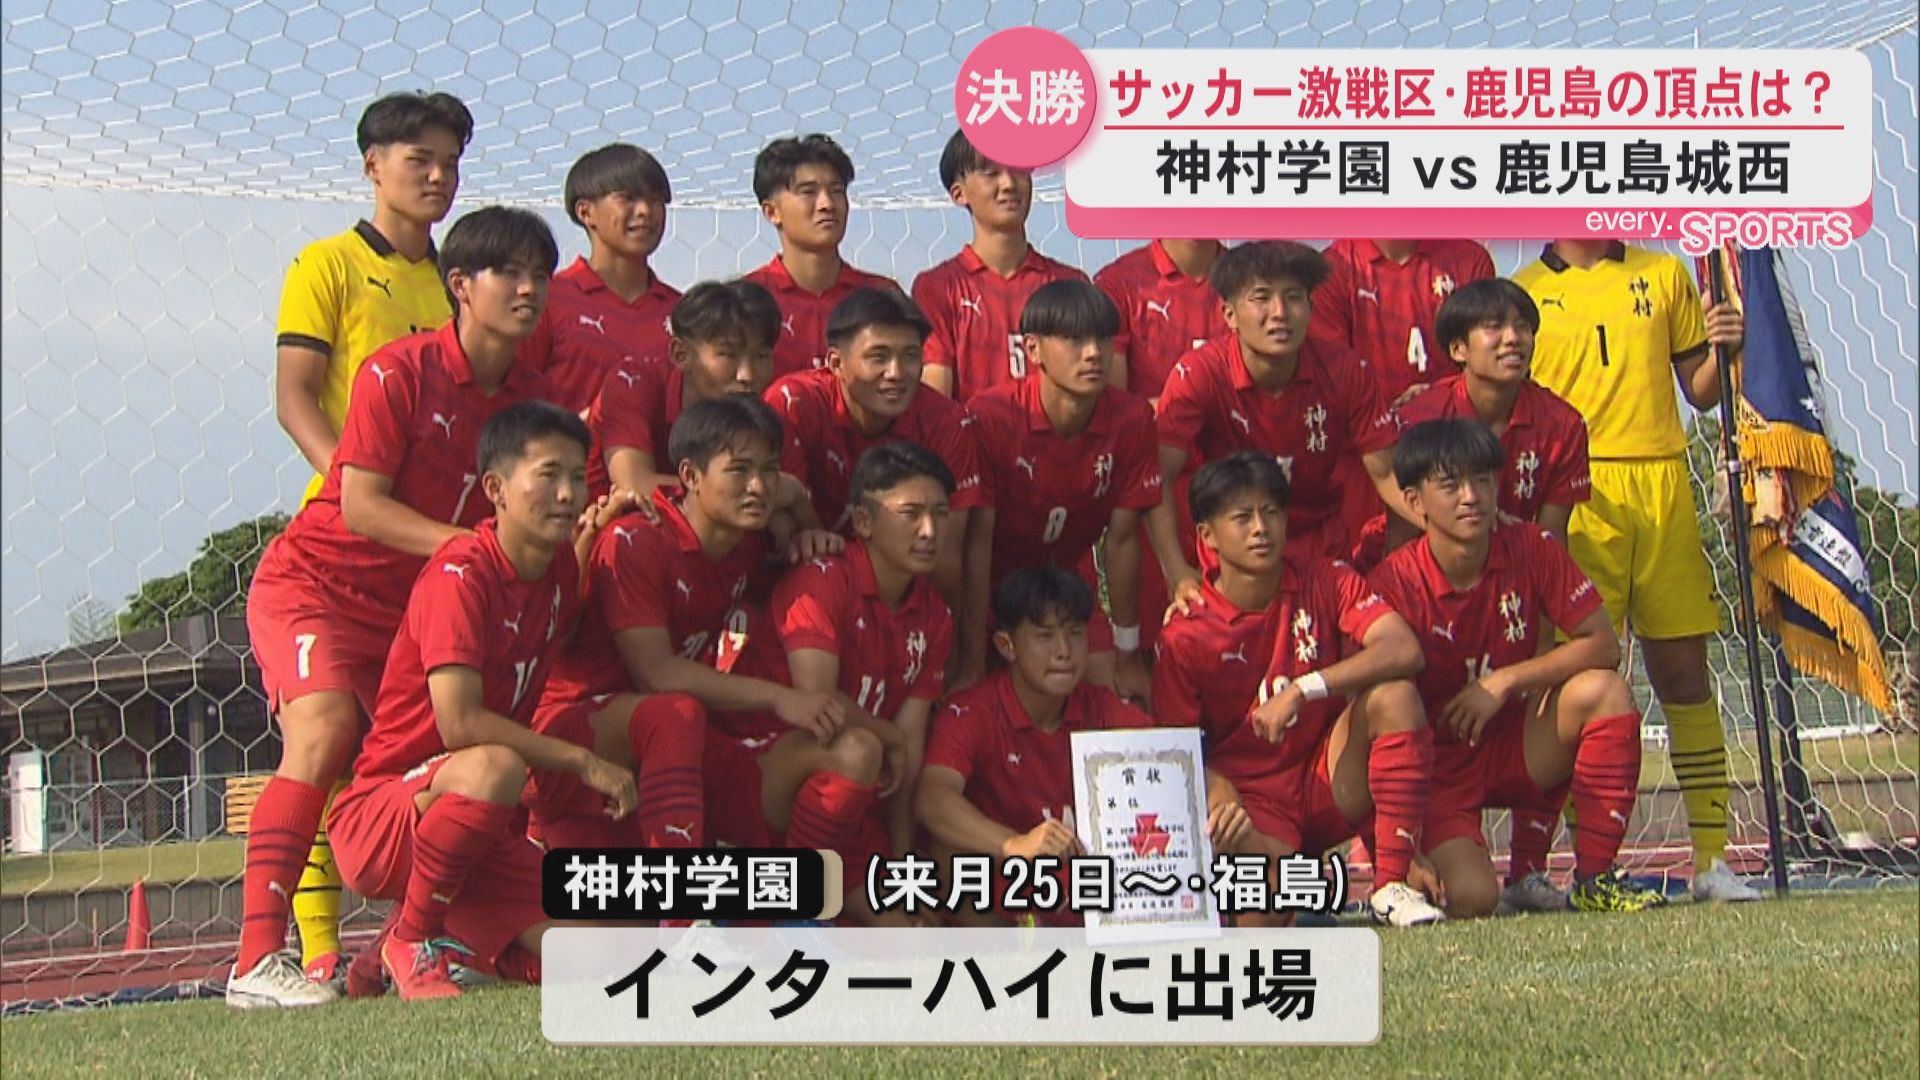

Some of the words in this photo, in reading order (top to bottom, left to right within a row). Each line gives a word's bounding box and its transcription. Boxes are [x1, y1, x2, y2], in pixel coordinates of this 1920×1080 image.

[1628, 276, 1652, 318] 神村
[1007, 333, 1027, 379] 5
[1407, 327, 1428, 373] 4
[1596, 324, 1610, 367] 1
[1303, 402, 1328, 453] 神村
[1514, 451, 1540, 499] 神村
[1043, 506, 1067, 543] 8
[1499, 590, 1527, 644] 神村
[295, 633, 317, 680] 7
